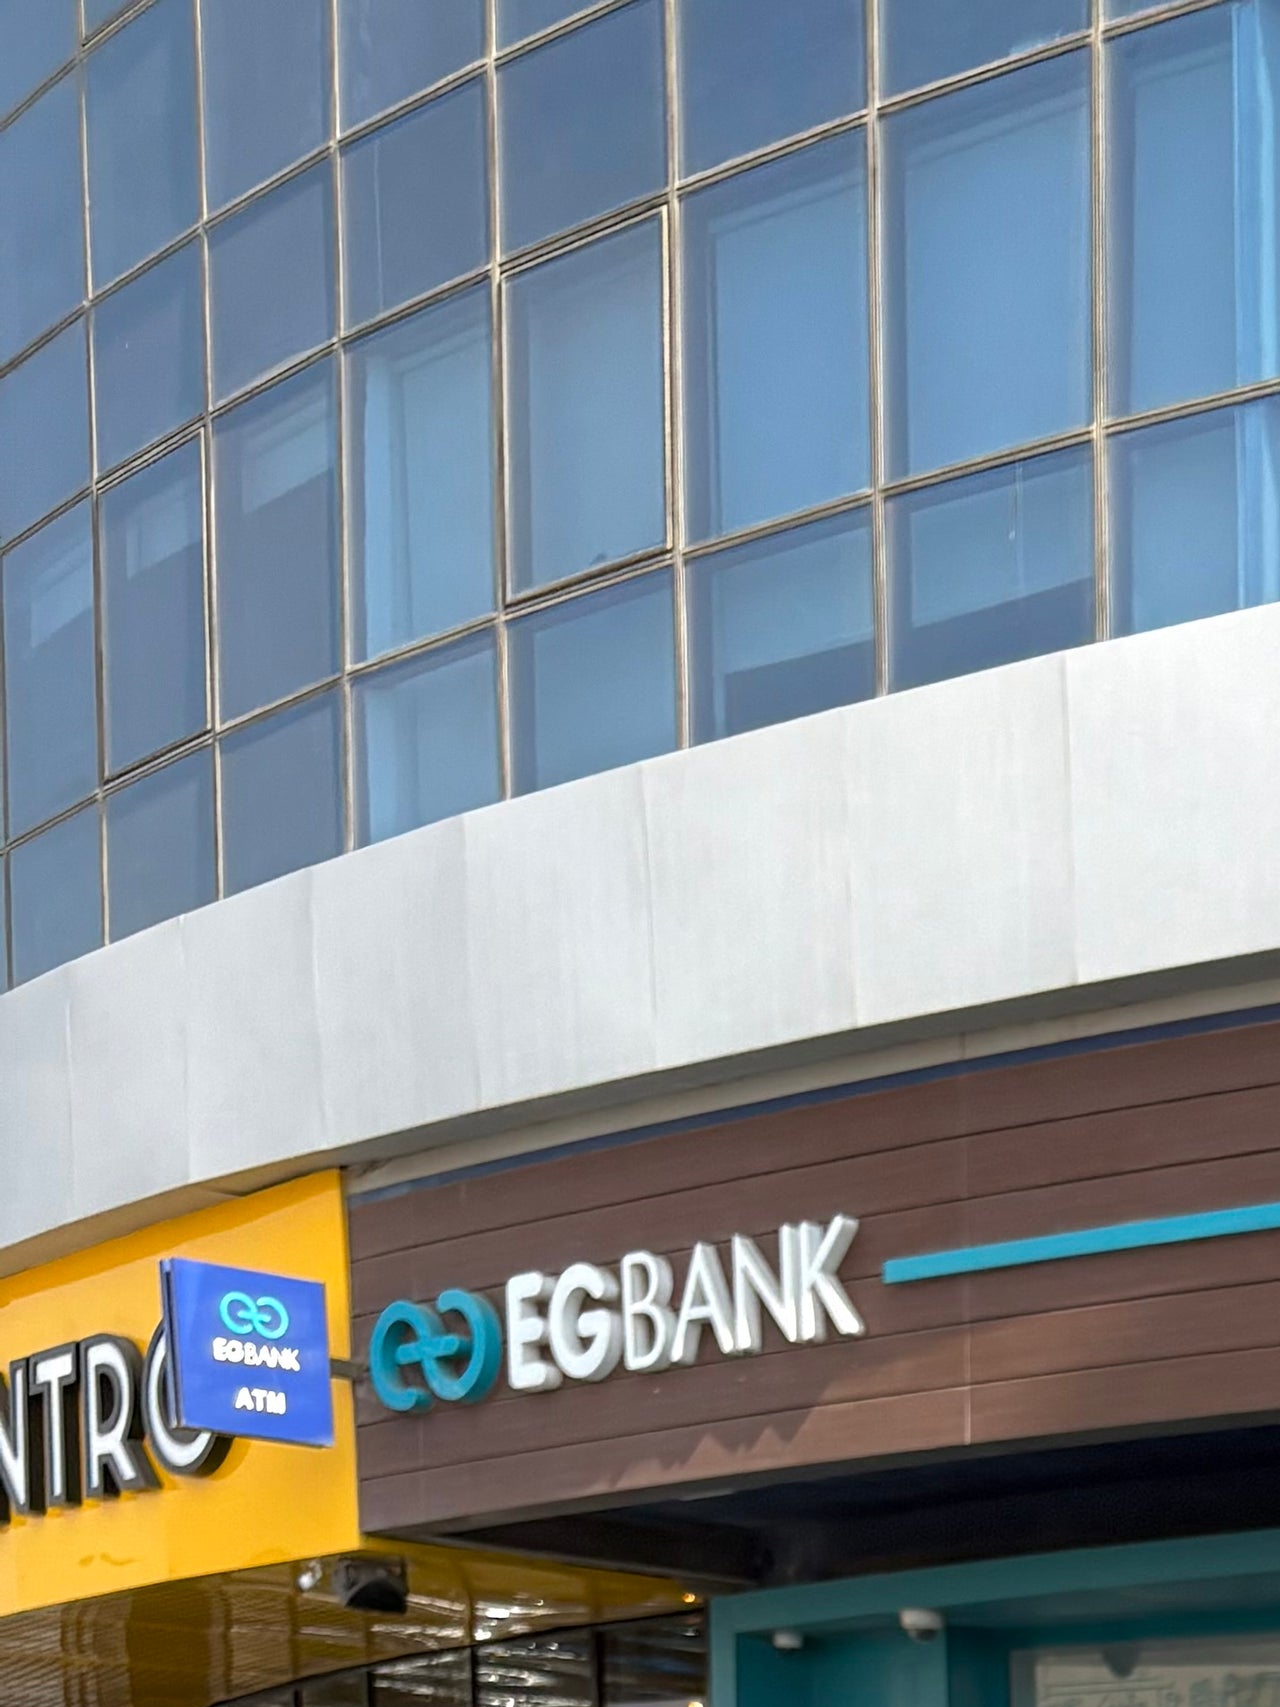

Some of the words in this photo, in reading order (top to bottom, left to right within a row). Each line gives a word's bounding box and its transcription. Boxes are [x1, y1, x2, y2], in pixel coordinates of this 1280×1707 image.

[505, 1212, 866, 1393] EGBANK
[212, 1336, 301, 1372] EGBANK
[235, 1386, 287, 1416] ATM
